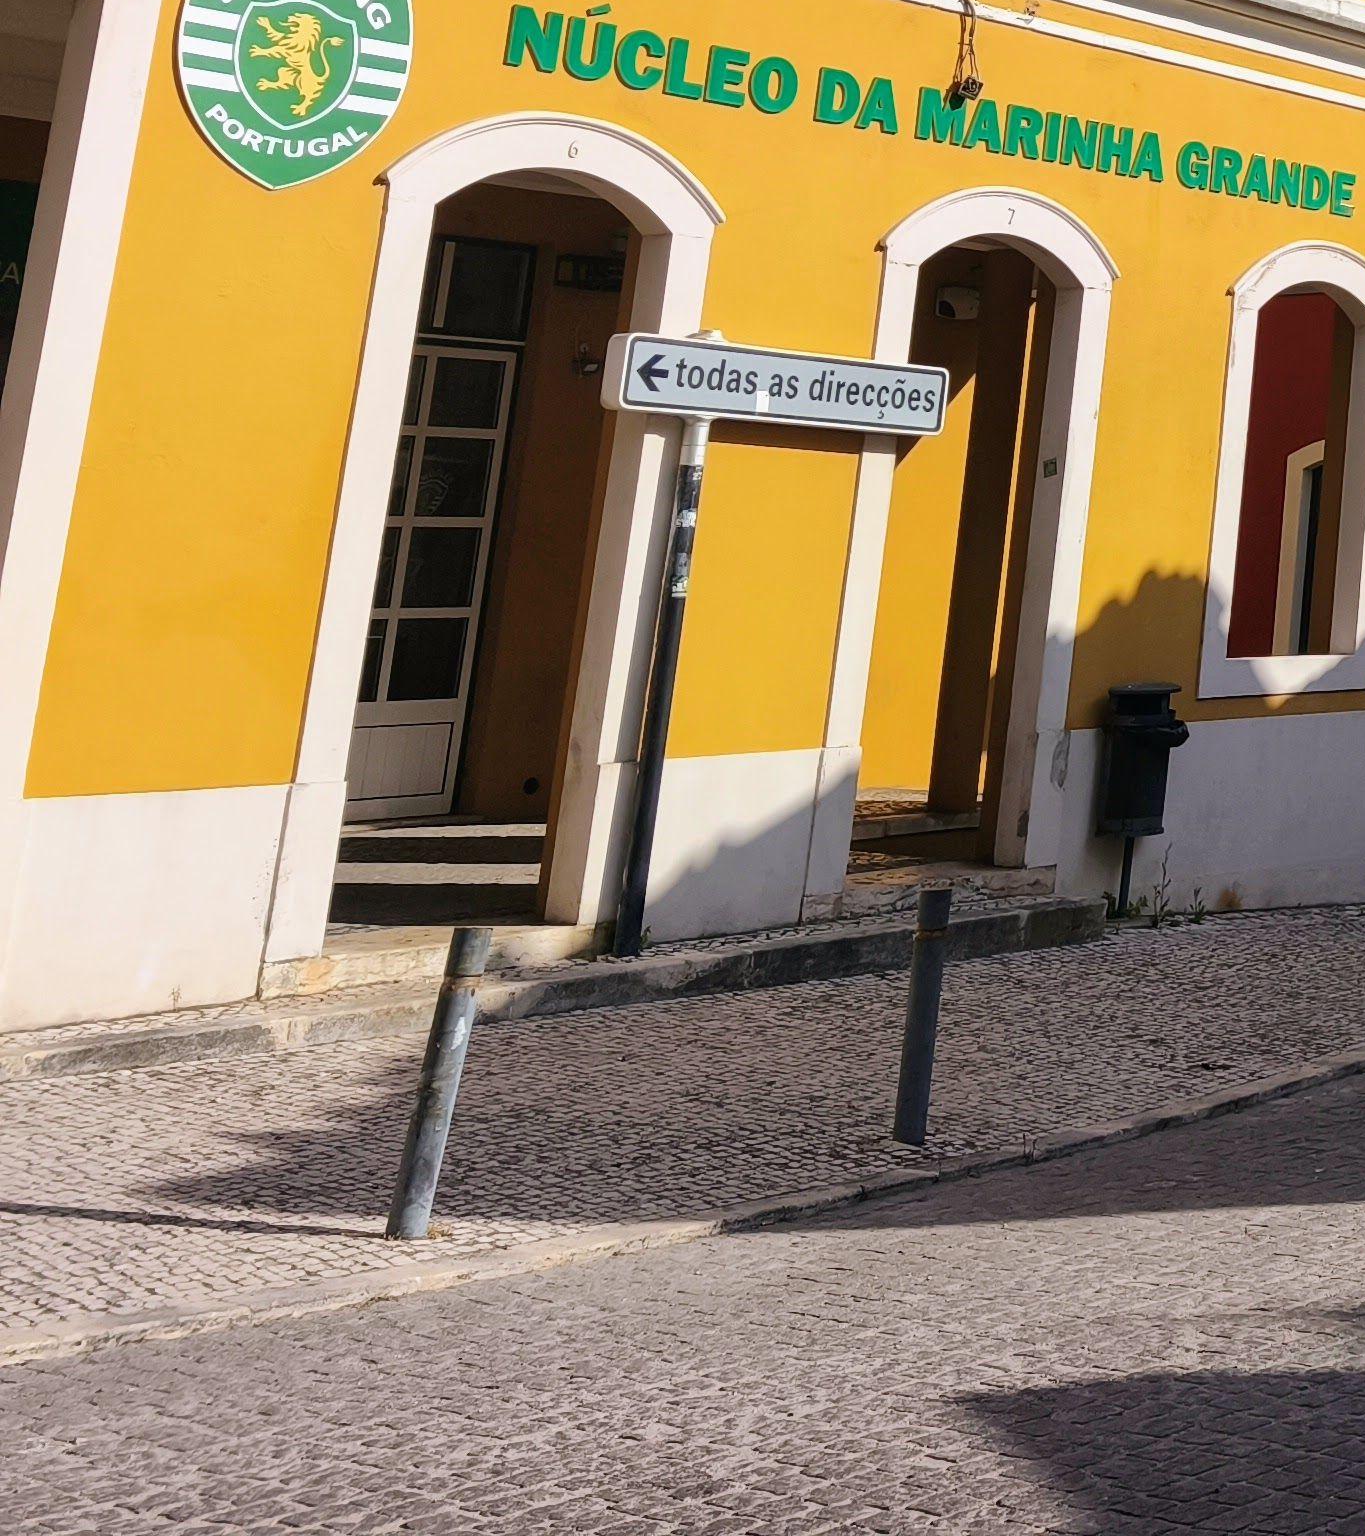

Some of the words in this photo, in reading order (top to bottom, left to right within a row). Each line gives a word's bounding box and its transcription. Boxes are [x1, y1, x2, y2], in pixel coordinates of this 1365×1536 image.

[204, 102, 370, 159] PORTUGAL
[503, 2, 799, 115] NÚCLEO
[814, 66, 899, 136] DA
[914, 87, 1164, 183] MARINHA
[1176, 141, 1357, 218] GRANDE
[675, 358, 759, 395] todas
[768, 373, 799, 400] as
[808, 370, 937, 418] direcções
